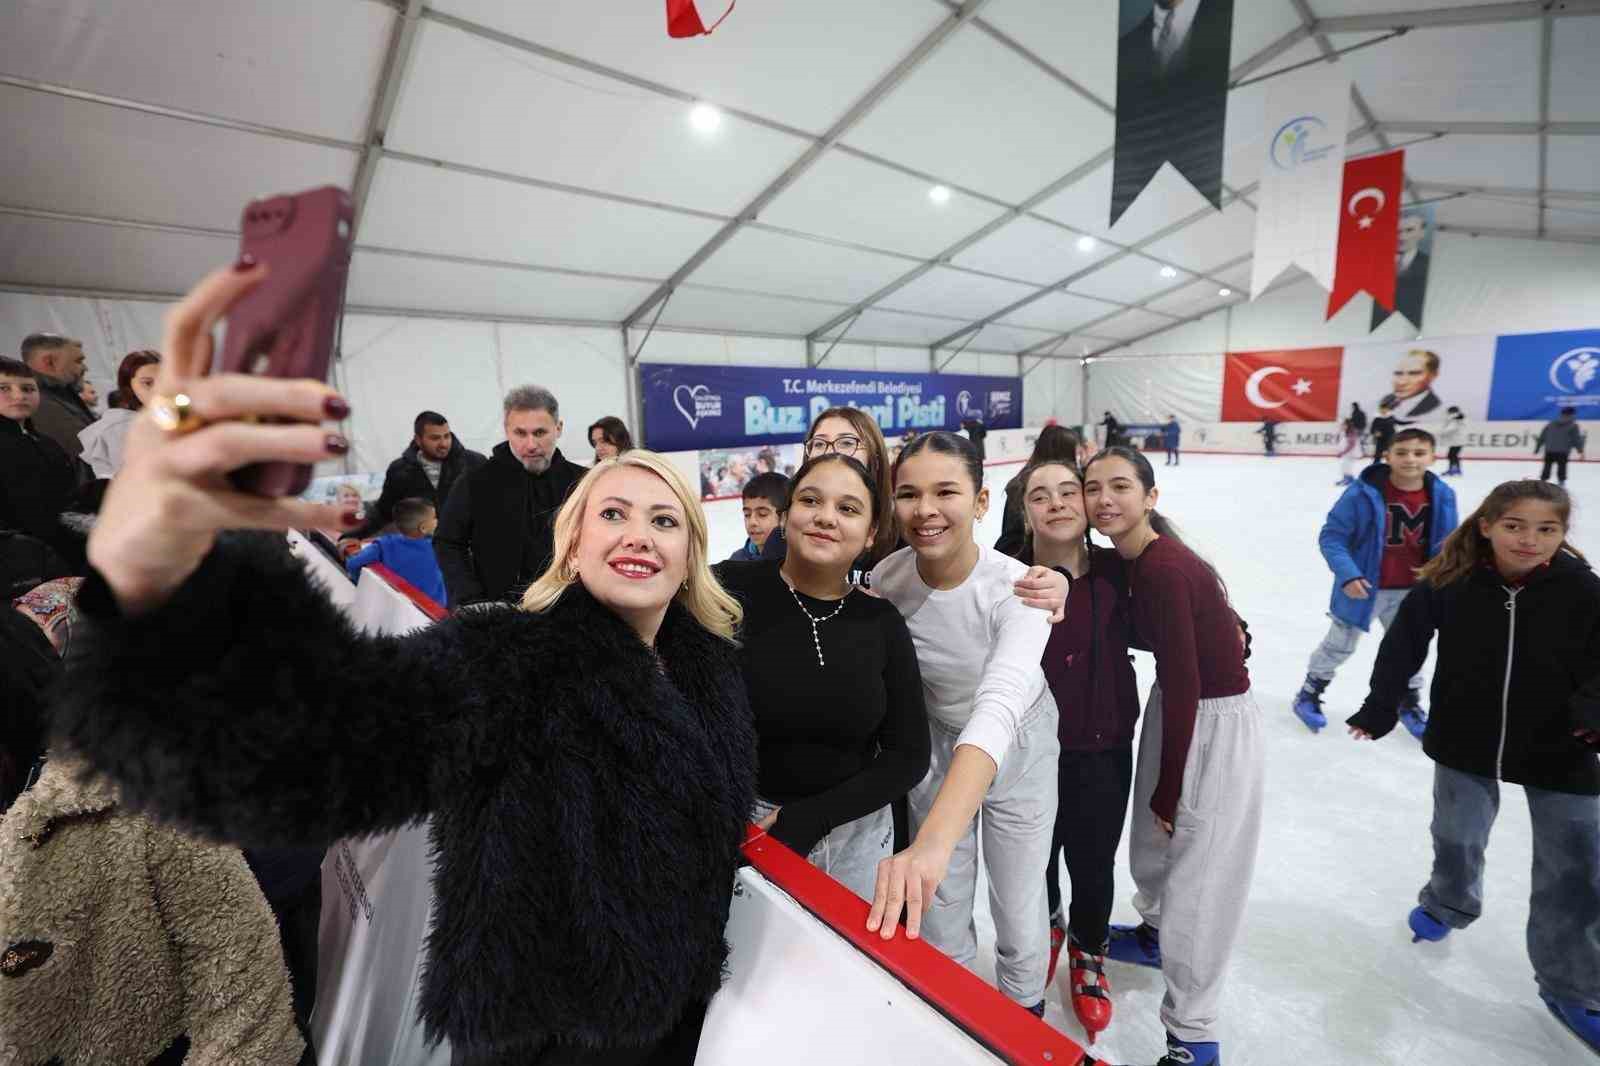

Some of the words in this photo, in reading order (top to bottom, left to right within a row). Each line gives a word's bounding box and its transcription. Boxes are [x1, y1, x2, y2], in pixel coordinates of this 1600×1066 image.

[783, 379, 804, 393] T.C.
[806, 380, 875, 394] Merkezefendi
[877, 381, 922, 396] Belediyesi
[744, 396, 807, 435] Buz
[897, 395, 945, 428] Pisti
